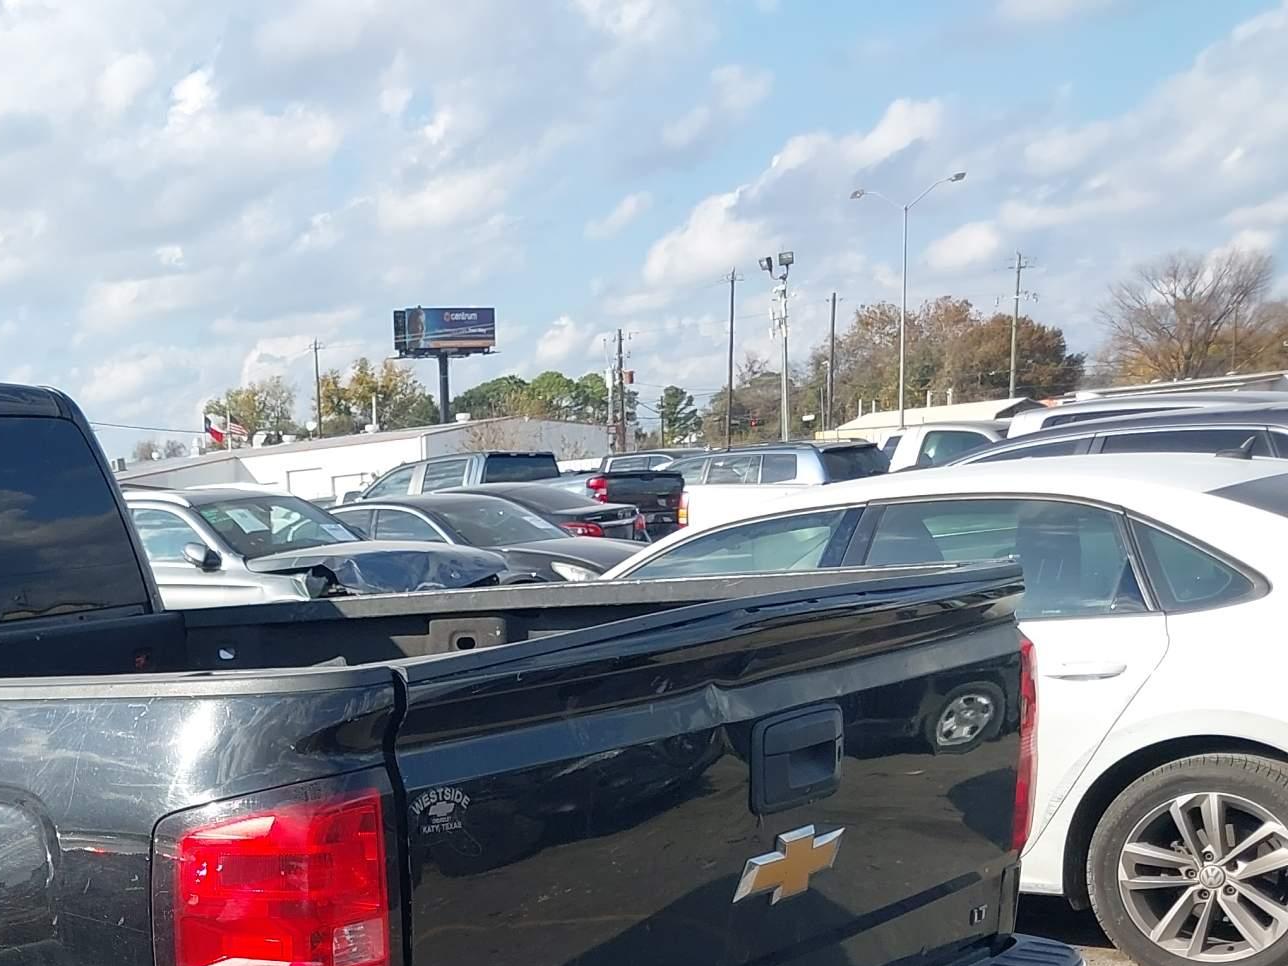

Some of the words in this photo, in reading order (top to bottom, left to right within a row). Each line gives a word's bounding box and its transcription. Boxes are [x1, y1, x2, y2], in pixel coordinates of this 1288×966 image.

[451, 312, 478, 321] centrum
[411, 788, 470, 815] WESTSIDE
[442, 821, 462, 832] TEXAS
[973, 904, 988, 924] LT
